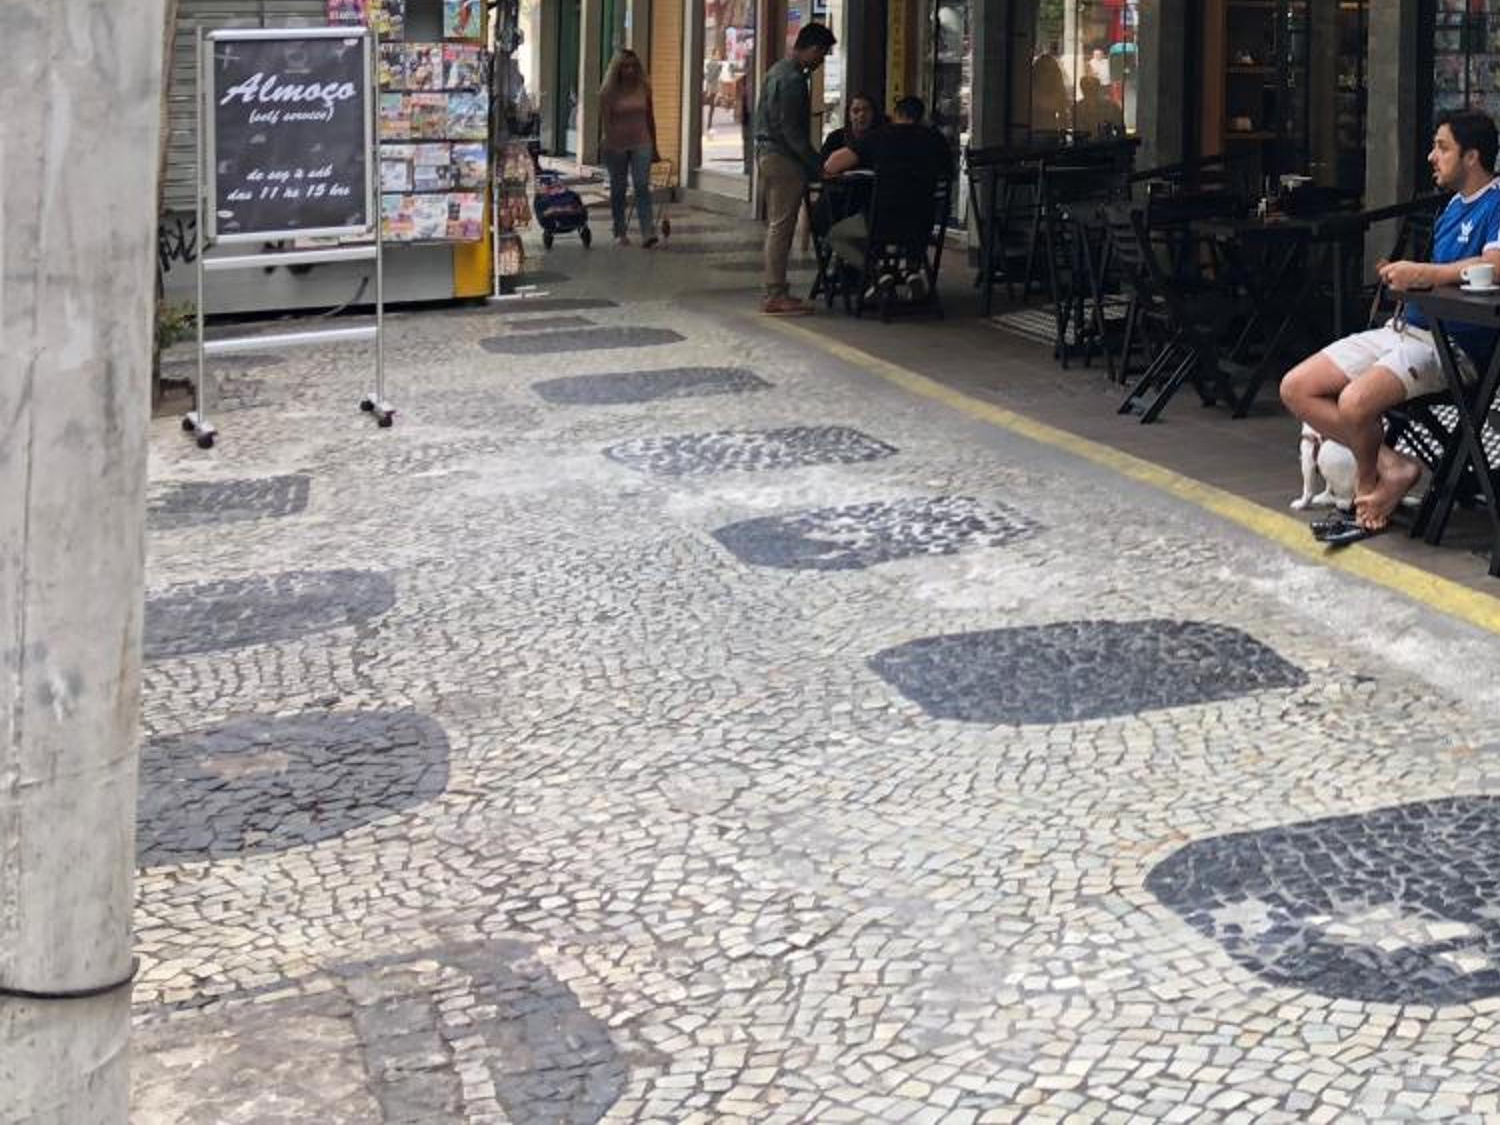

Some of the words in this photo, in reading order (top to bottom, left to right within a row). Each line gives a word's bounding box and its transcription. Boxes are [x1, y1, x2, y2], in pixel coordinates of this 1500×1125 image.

[219, 72, 356, 107] Almoço
[259, 186, 279, 200] 11
[305, 183, 326, 198] 15
